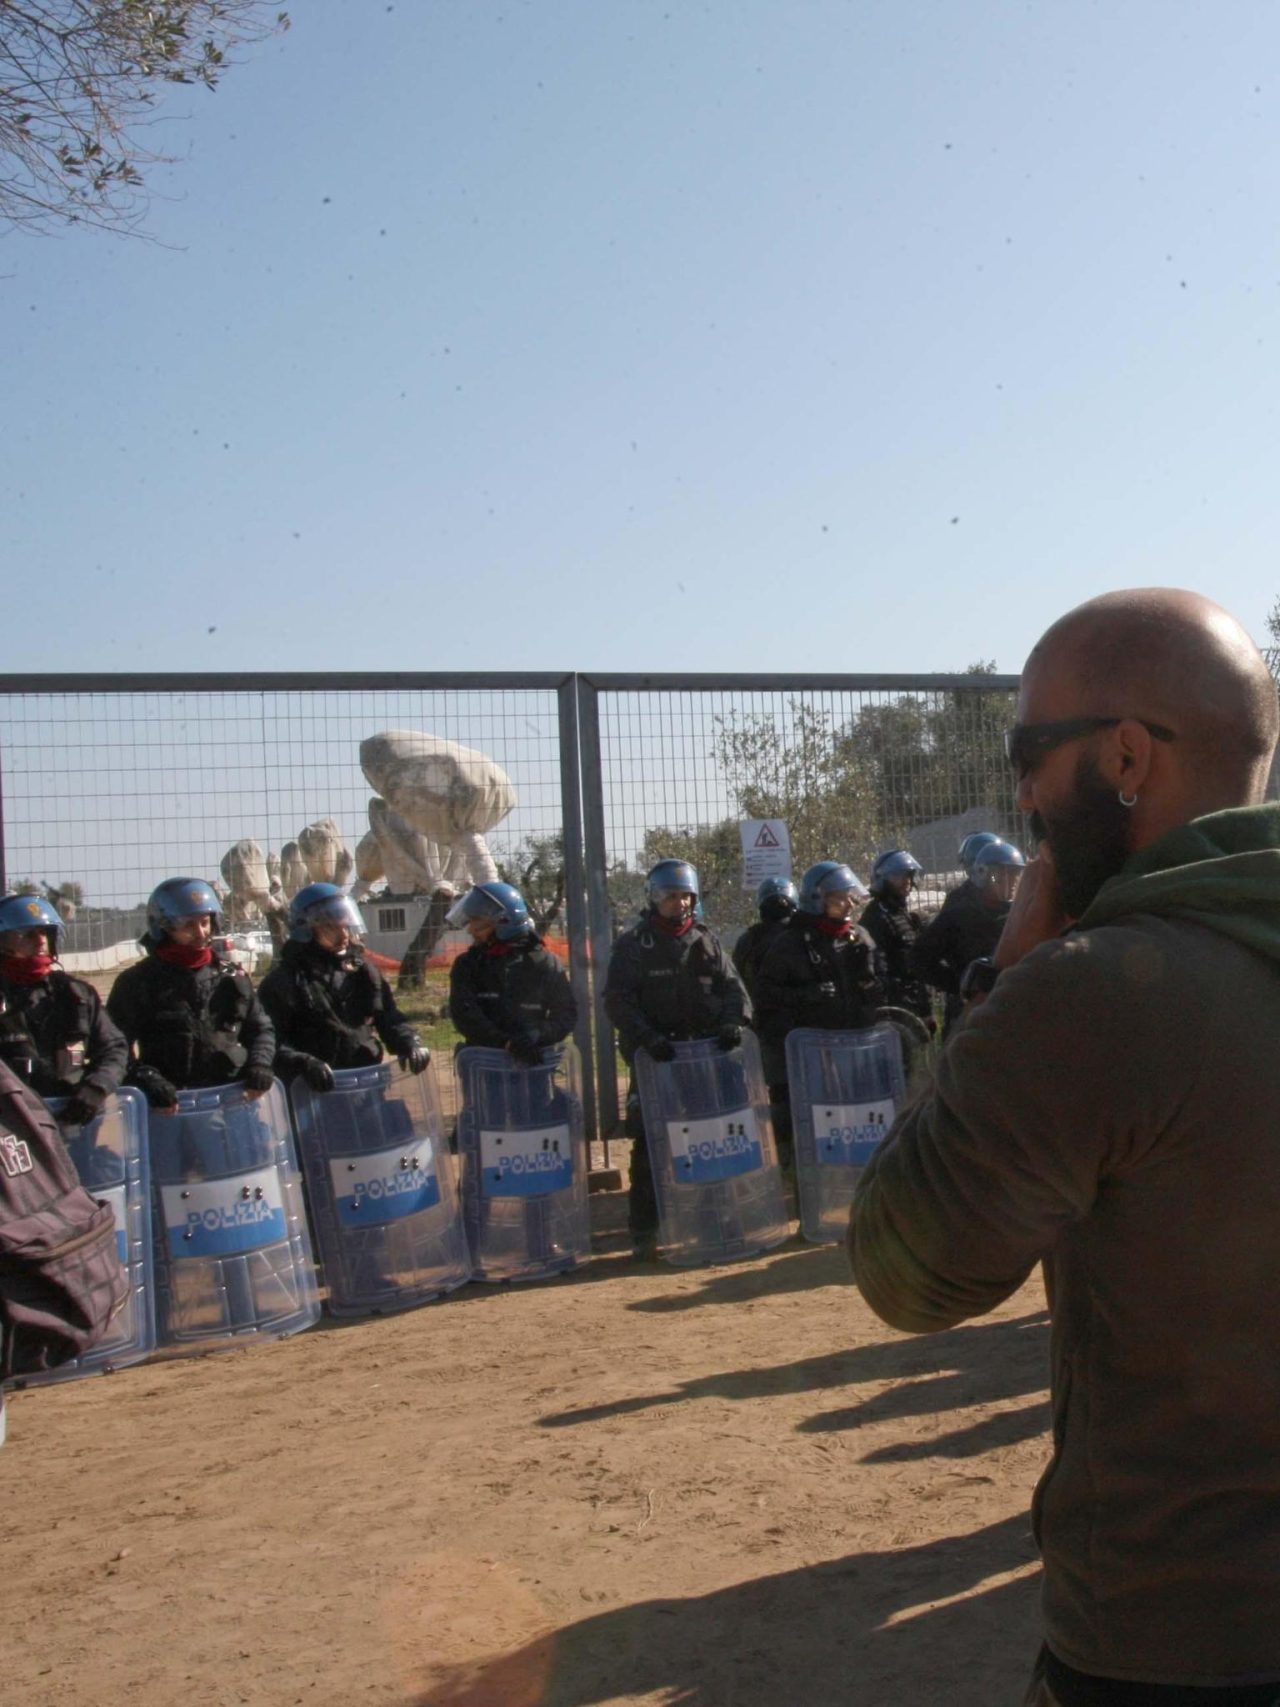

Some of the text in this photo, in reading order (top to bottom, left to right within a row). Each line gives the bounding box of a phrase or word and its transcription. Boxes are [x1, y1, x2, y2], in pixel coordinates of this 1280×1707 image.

[499, 1151, 565, 1176] POLIZIA
[688, 1135, 752, 1163] POLIZIA
[353, 1169, 429, 1203] POLIZIA
[187, 1200, 274, 1234] POLIZIA
